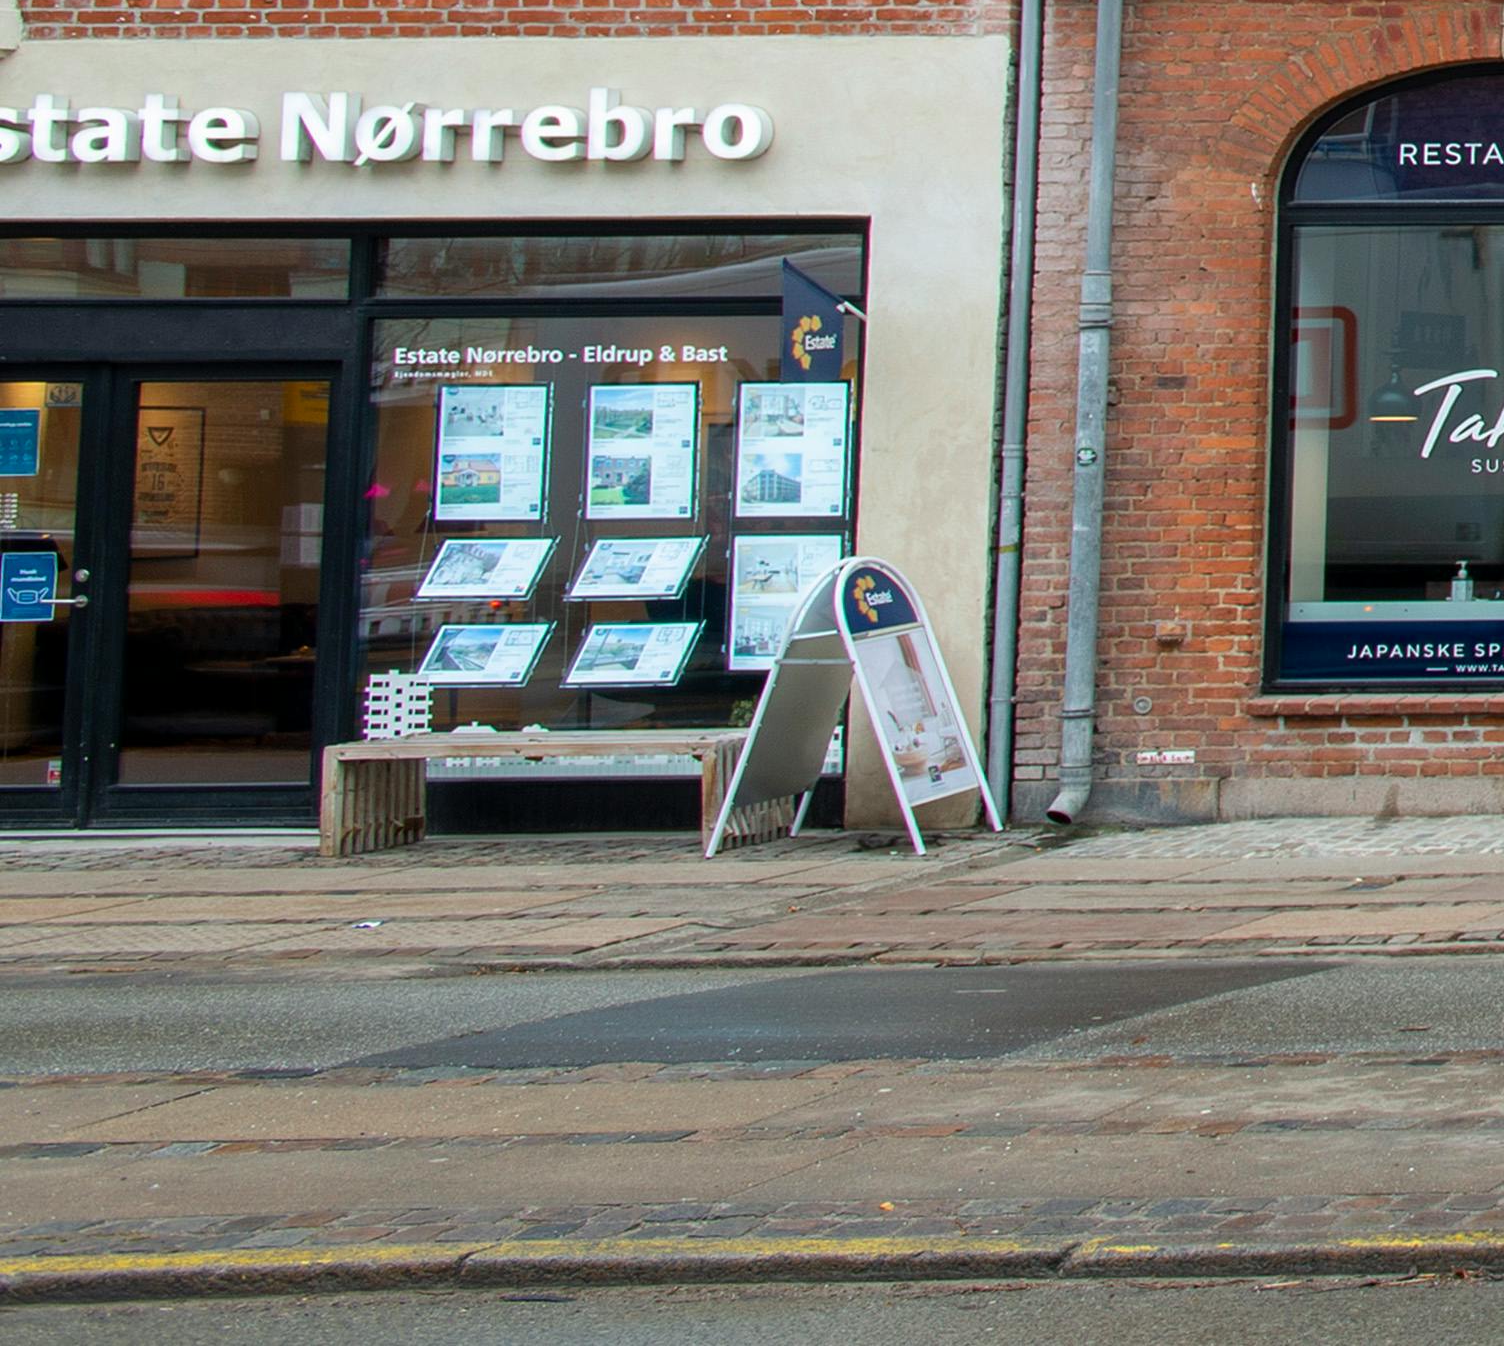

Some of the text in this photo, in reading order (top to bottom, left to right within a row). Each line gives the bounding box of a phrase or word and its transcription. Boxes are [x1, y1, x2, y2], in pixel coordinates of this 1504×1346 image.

[280, 86, 775, 168] Nørrebro
[804, 334, 837, 351] Estate
[394, 347, 461, 365] Estate
[465, 346, 564, 365] Nørrebro
[582, 344, 654, 367] Eldrup
[658, 344, 676, 364] &
[681, 344, 729, 363] Bast
[1347, 643, 1466, 659] JAPANSKE
